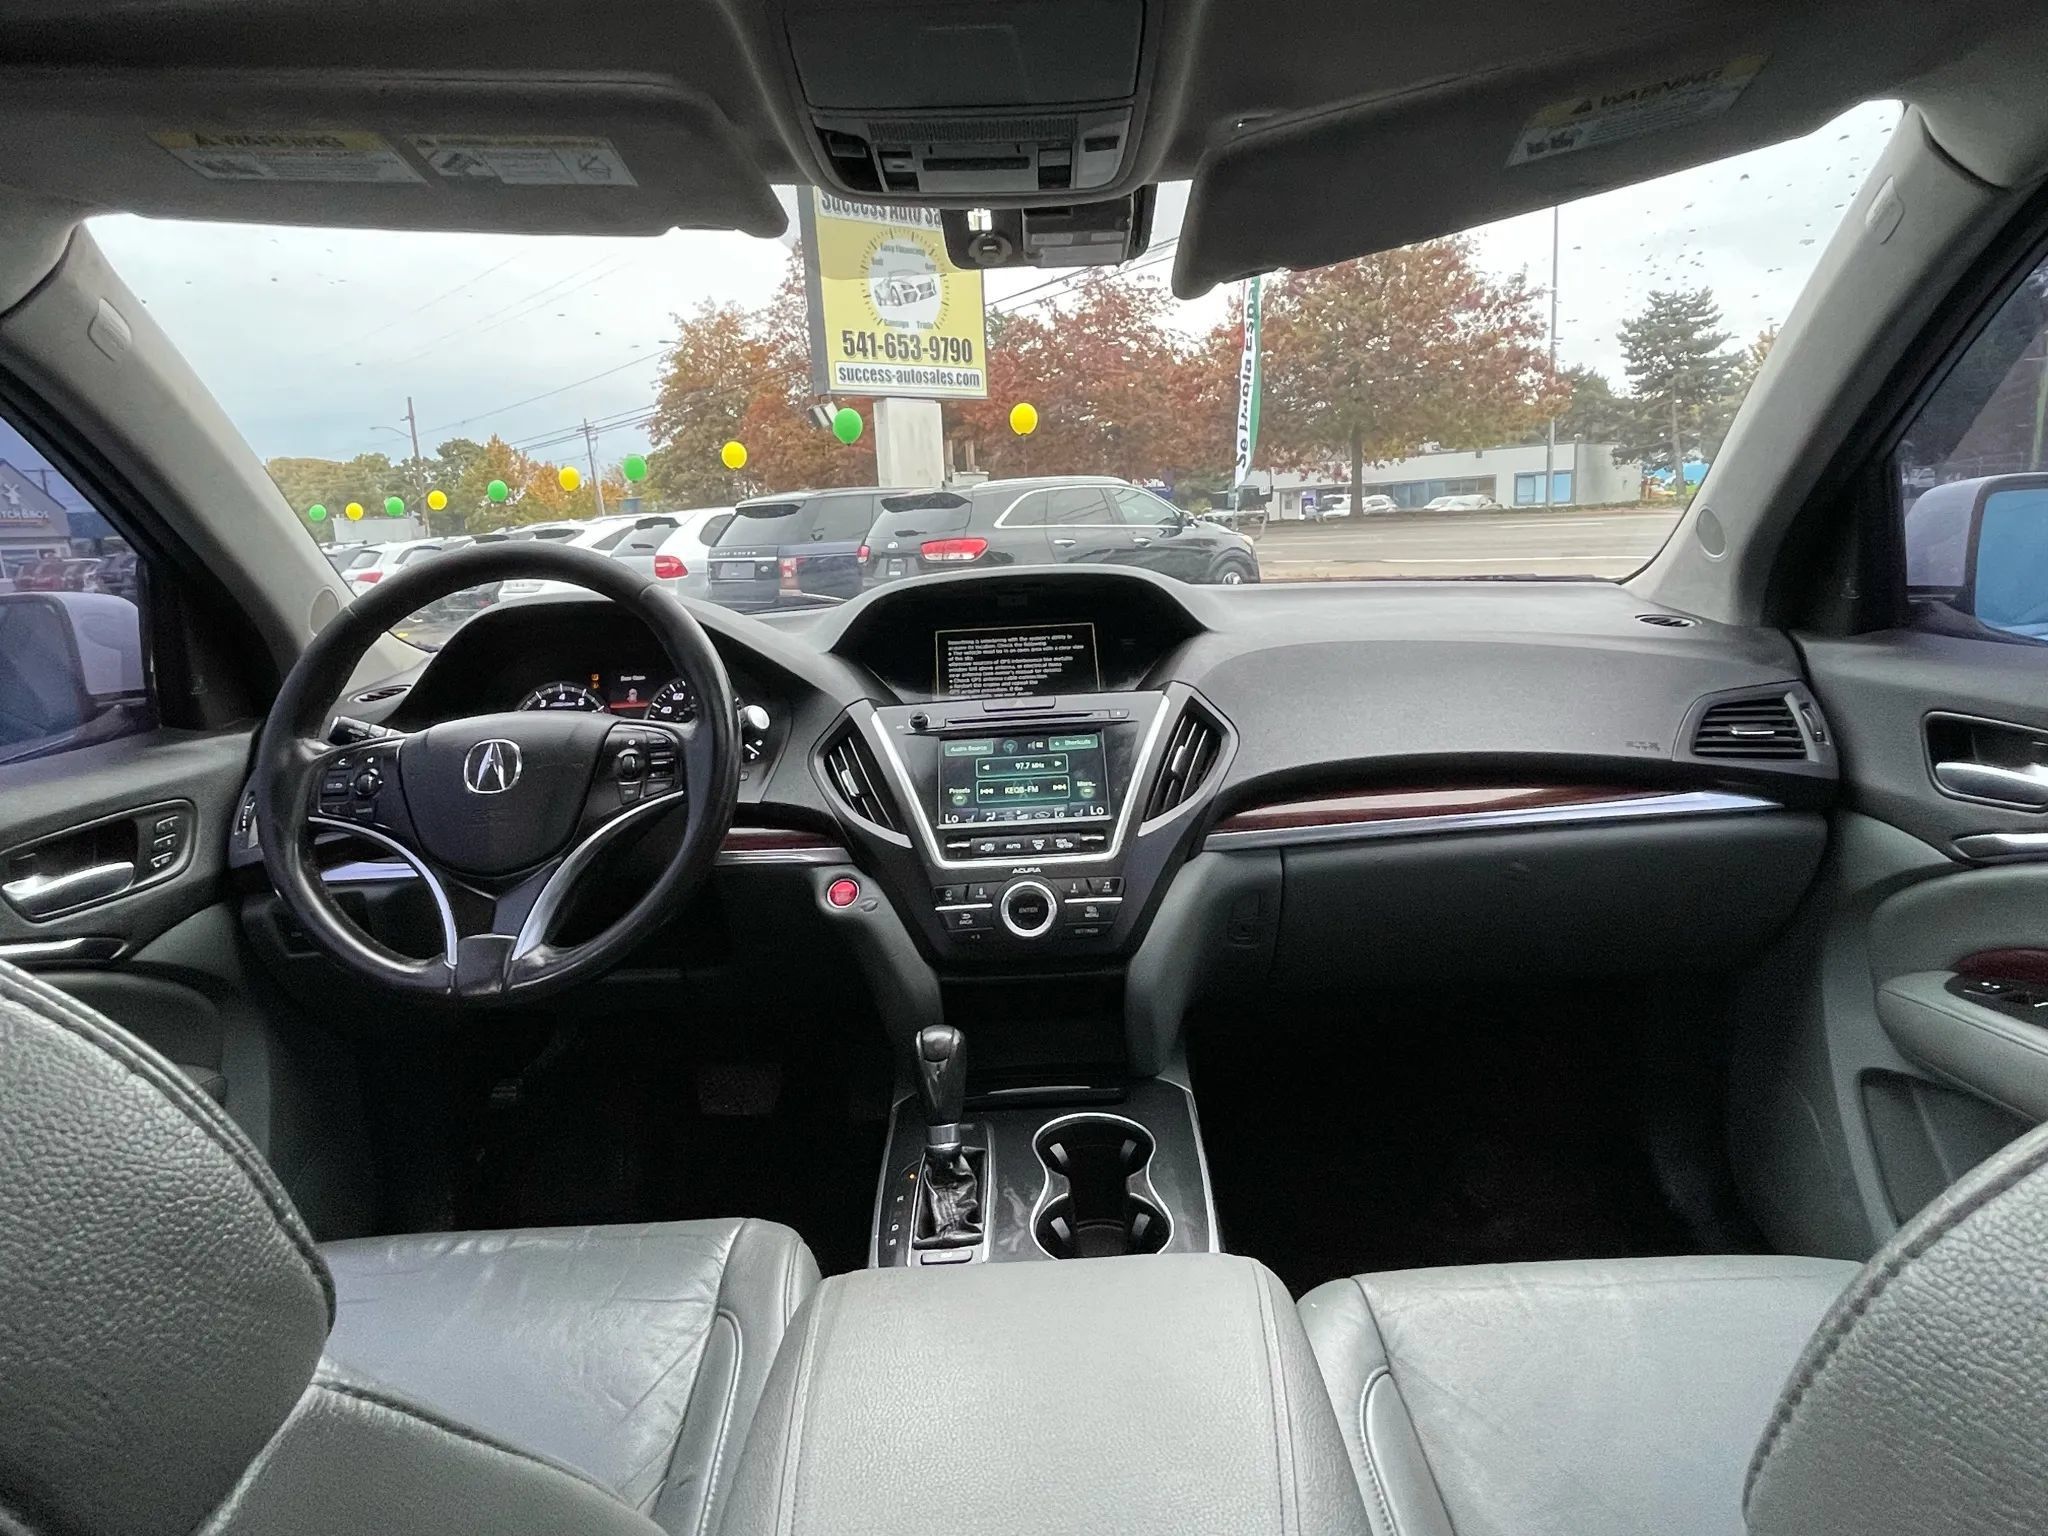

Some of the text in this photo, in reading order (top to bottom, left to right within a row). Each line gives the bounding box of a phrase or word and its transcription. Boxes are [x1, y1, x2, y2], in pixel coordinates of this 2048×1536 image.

[842, 330, 973, 363] 541-653-9790
[838, 367, 980, 387] success-autosales.com
[558, 692, 566, 700] 4
[539, 700, 546, 708] 3
[578, 698, 584, 706] 5
[1014, 762, 1030, 770] 97.7
[1090, 806, 1104, 816] Lo
[944, 814, 959, 824] Lo
